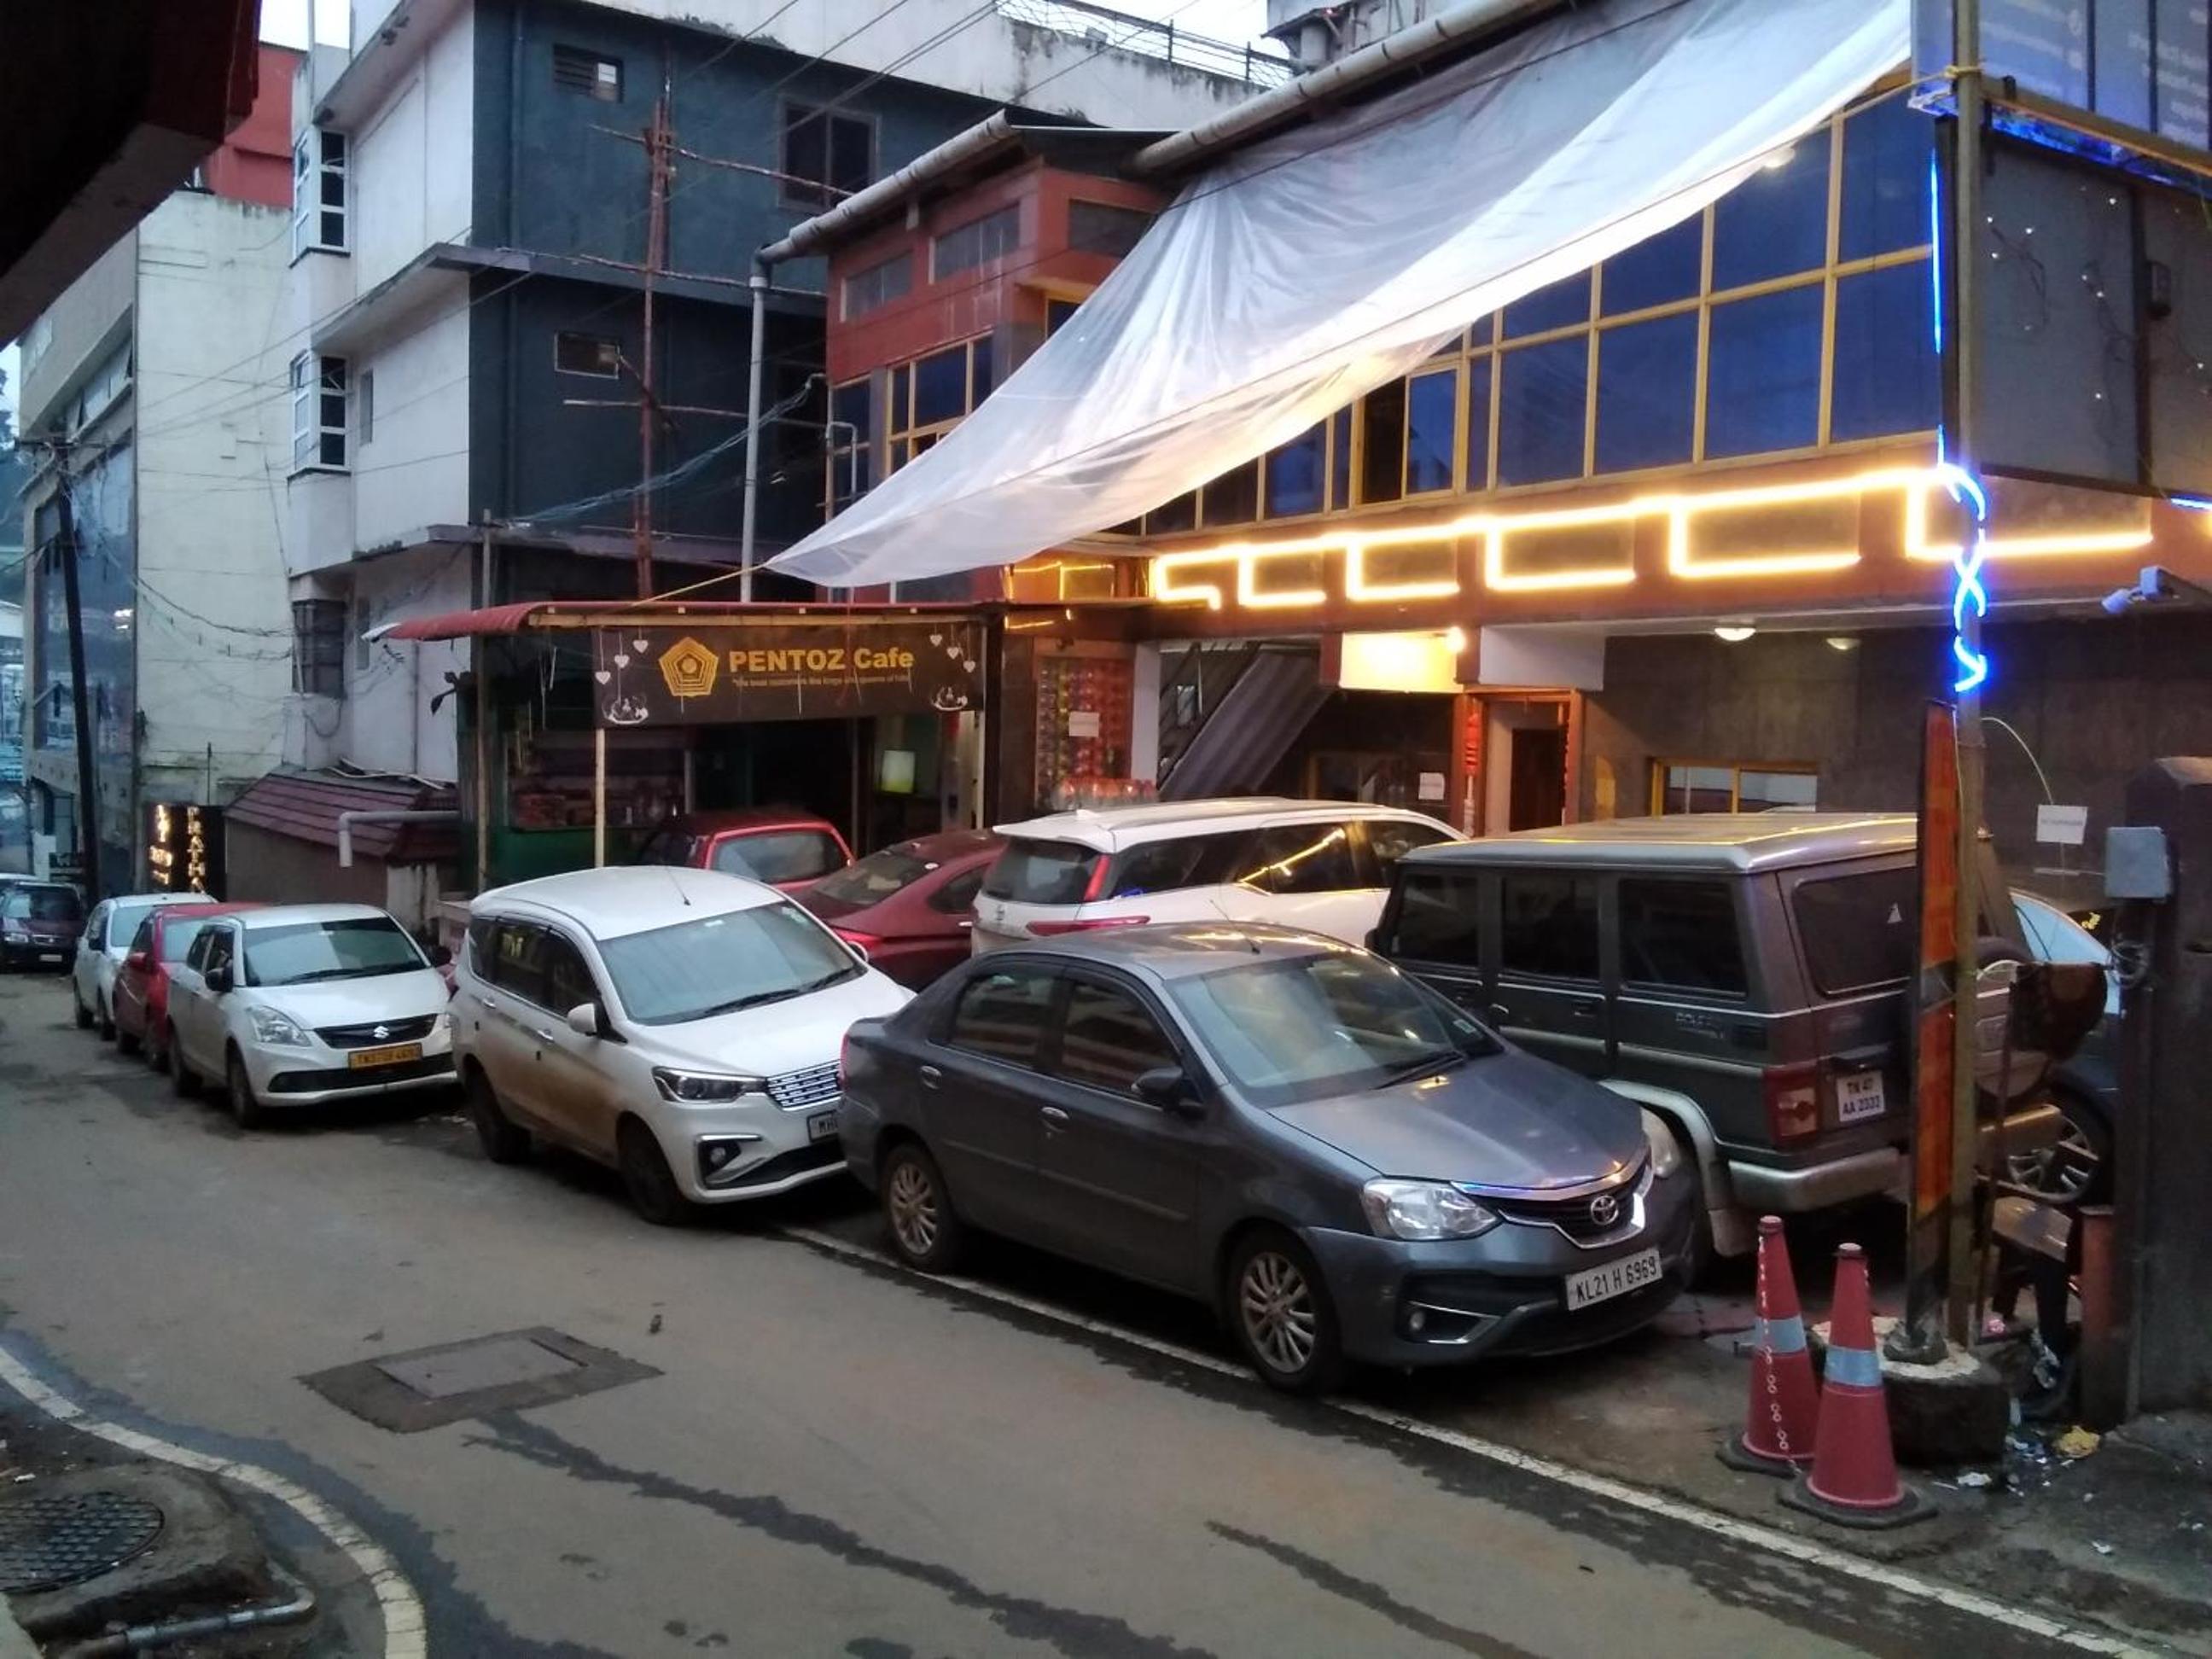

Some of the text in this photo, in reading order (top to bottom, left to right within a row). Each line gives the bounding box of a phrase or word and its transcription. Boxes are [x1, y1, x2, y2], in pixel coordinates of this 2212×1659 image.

[729, 647, 914, 672] PENTOZ Cafe
[1575, 1273, 1609, 1303] KL21
[1626, 1255, 1657, 1284] 6969
